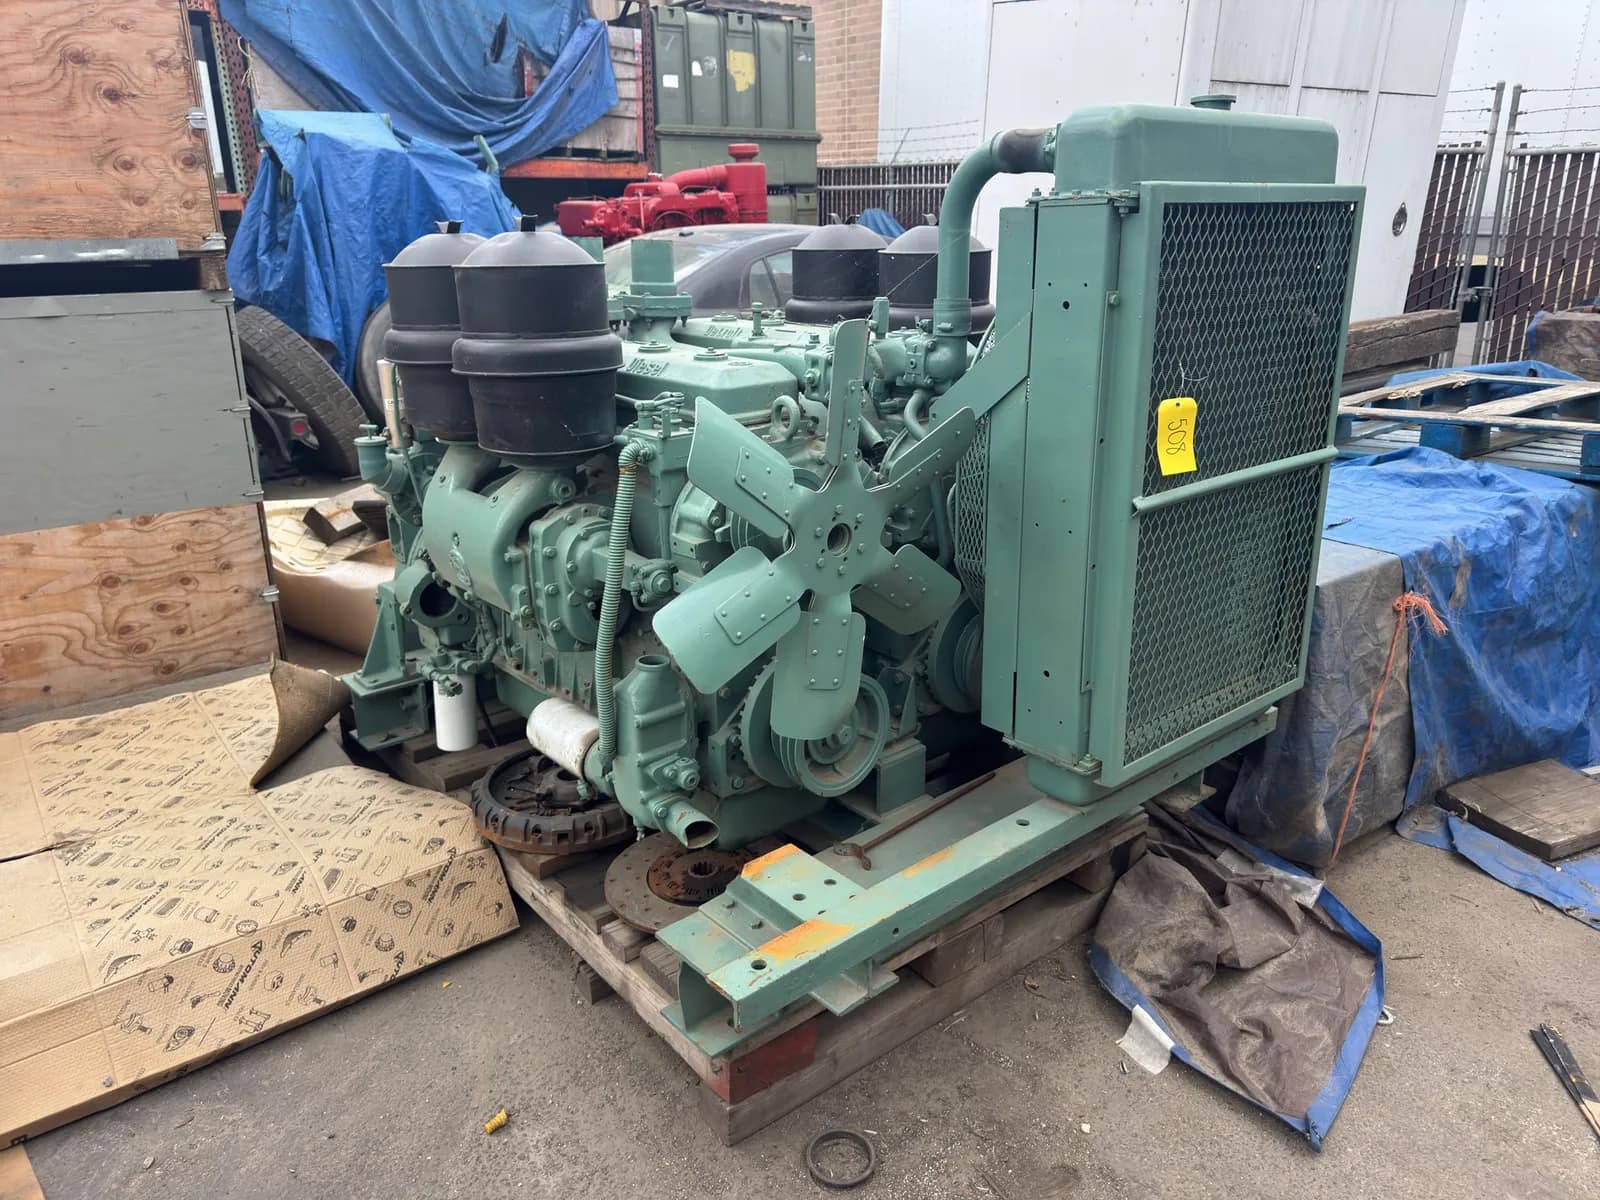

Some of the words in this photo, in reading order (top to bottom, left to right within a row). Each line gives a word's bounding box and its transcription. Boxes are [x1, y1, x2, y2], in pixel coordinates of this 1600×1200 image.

[626, 357, 670, 377] Diesel
[1165, 418, 1188, 456] 508
[427, 846, 458, 905] AUTOMANN
[223, 939, 265, 1011] AUTOMANN
